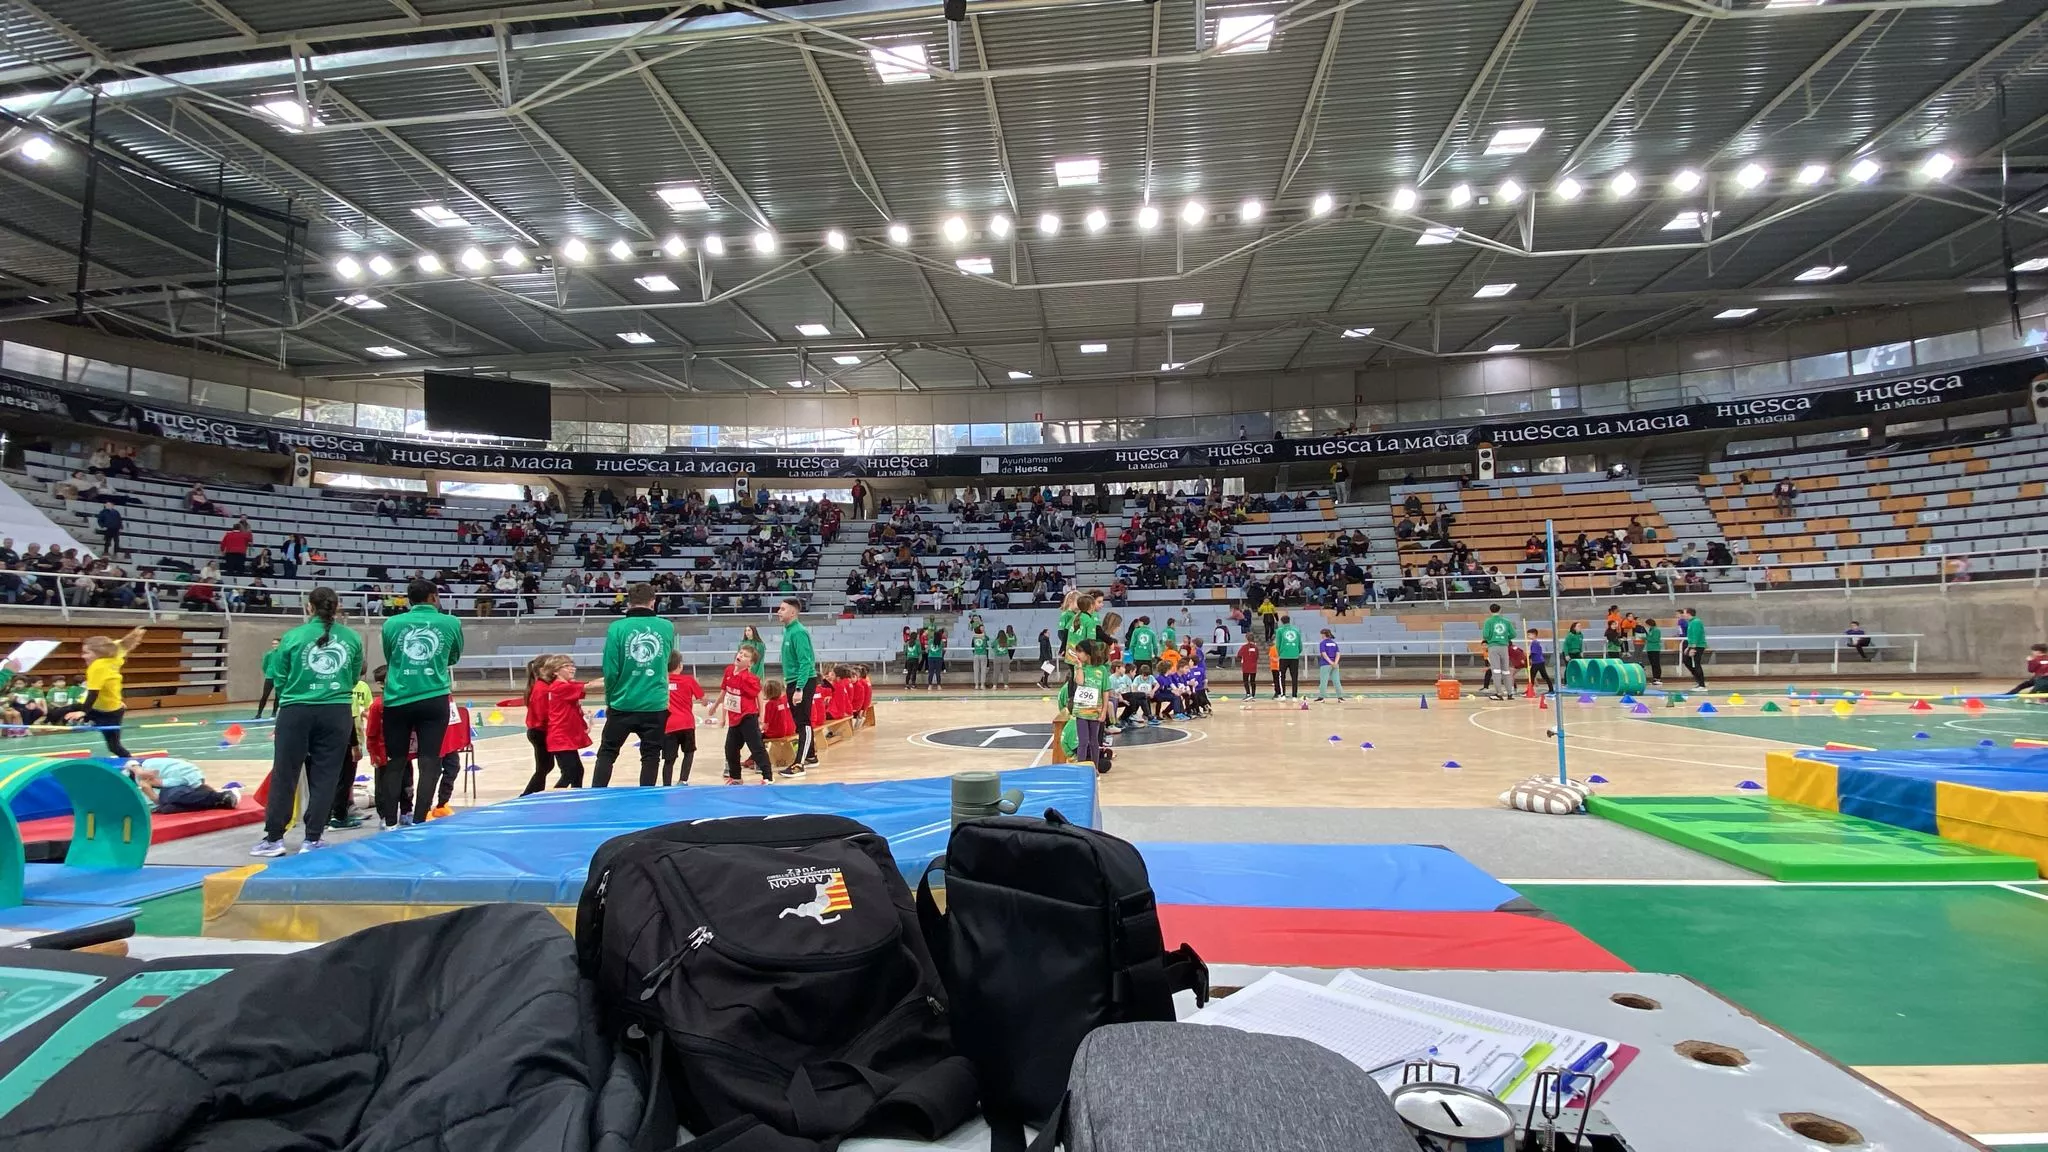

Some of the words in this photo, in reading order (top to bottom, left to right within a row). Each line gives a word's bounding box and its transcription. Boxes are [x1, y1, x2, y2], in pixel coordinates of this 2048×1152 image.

[0, 381, 61, 402] amiento
[1585, 421, 1611, 436] La
[1376, 437, 1399, 451] La
[483, 454, 505, 468] La
[675, 459, 695, 472] La
[1001, 456, 1063, 466] Ayuntamiento
[1001, 466, 1013, 474] de
[1014, 465, 1048, 473] Huesca
[1079, 690, 1094, 700] 296
[769, 874, 824, 890] ARAGÓN
